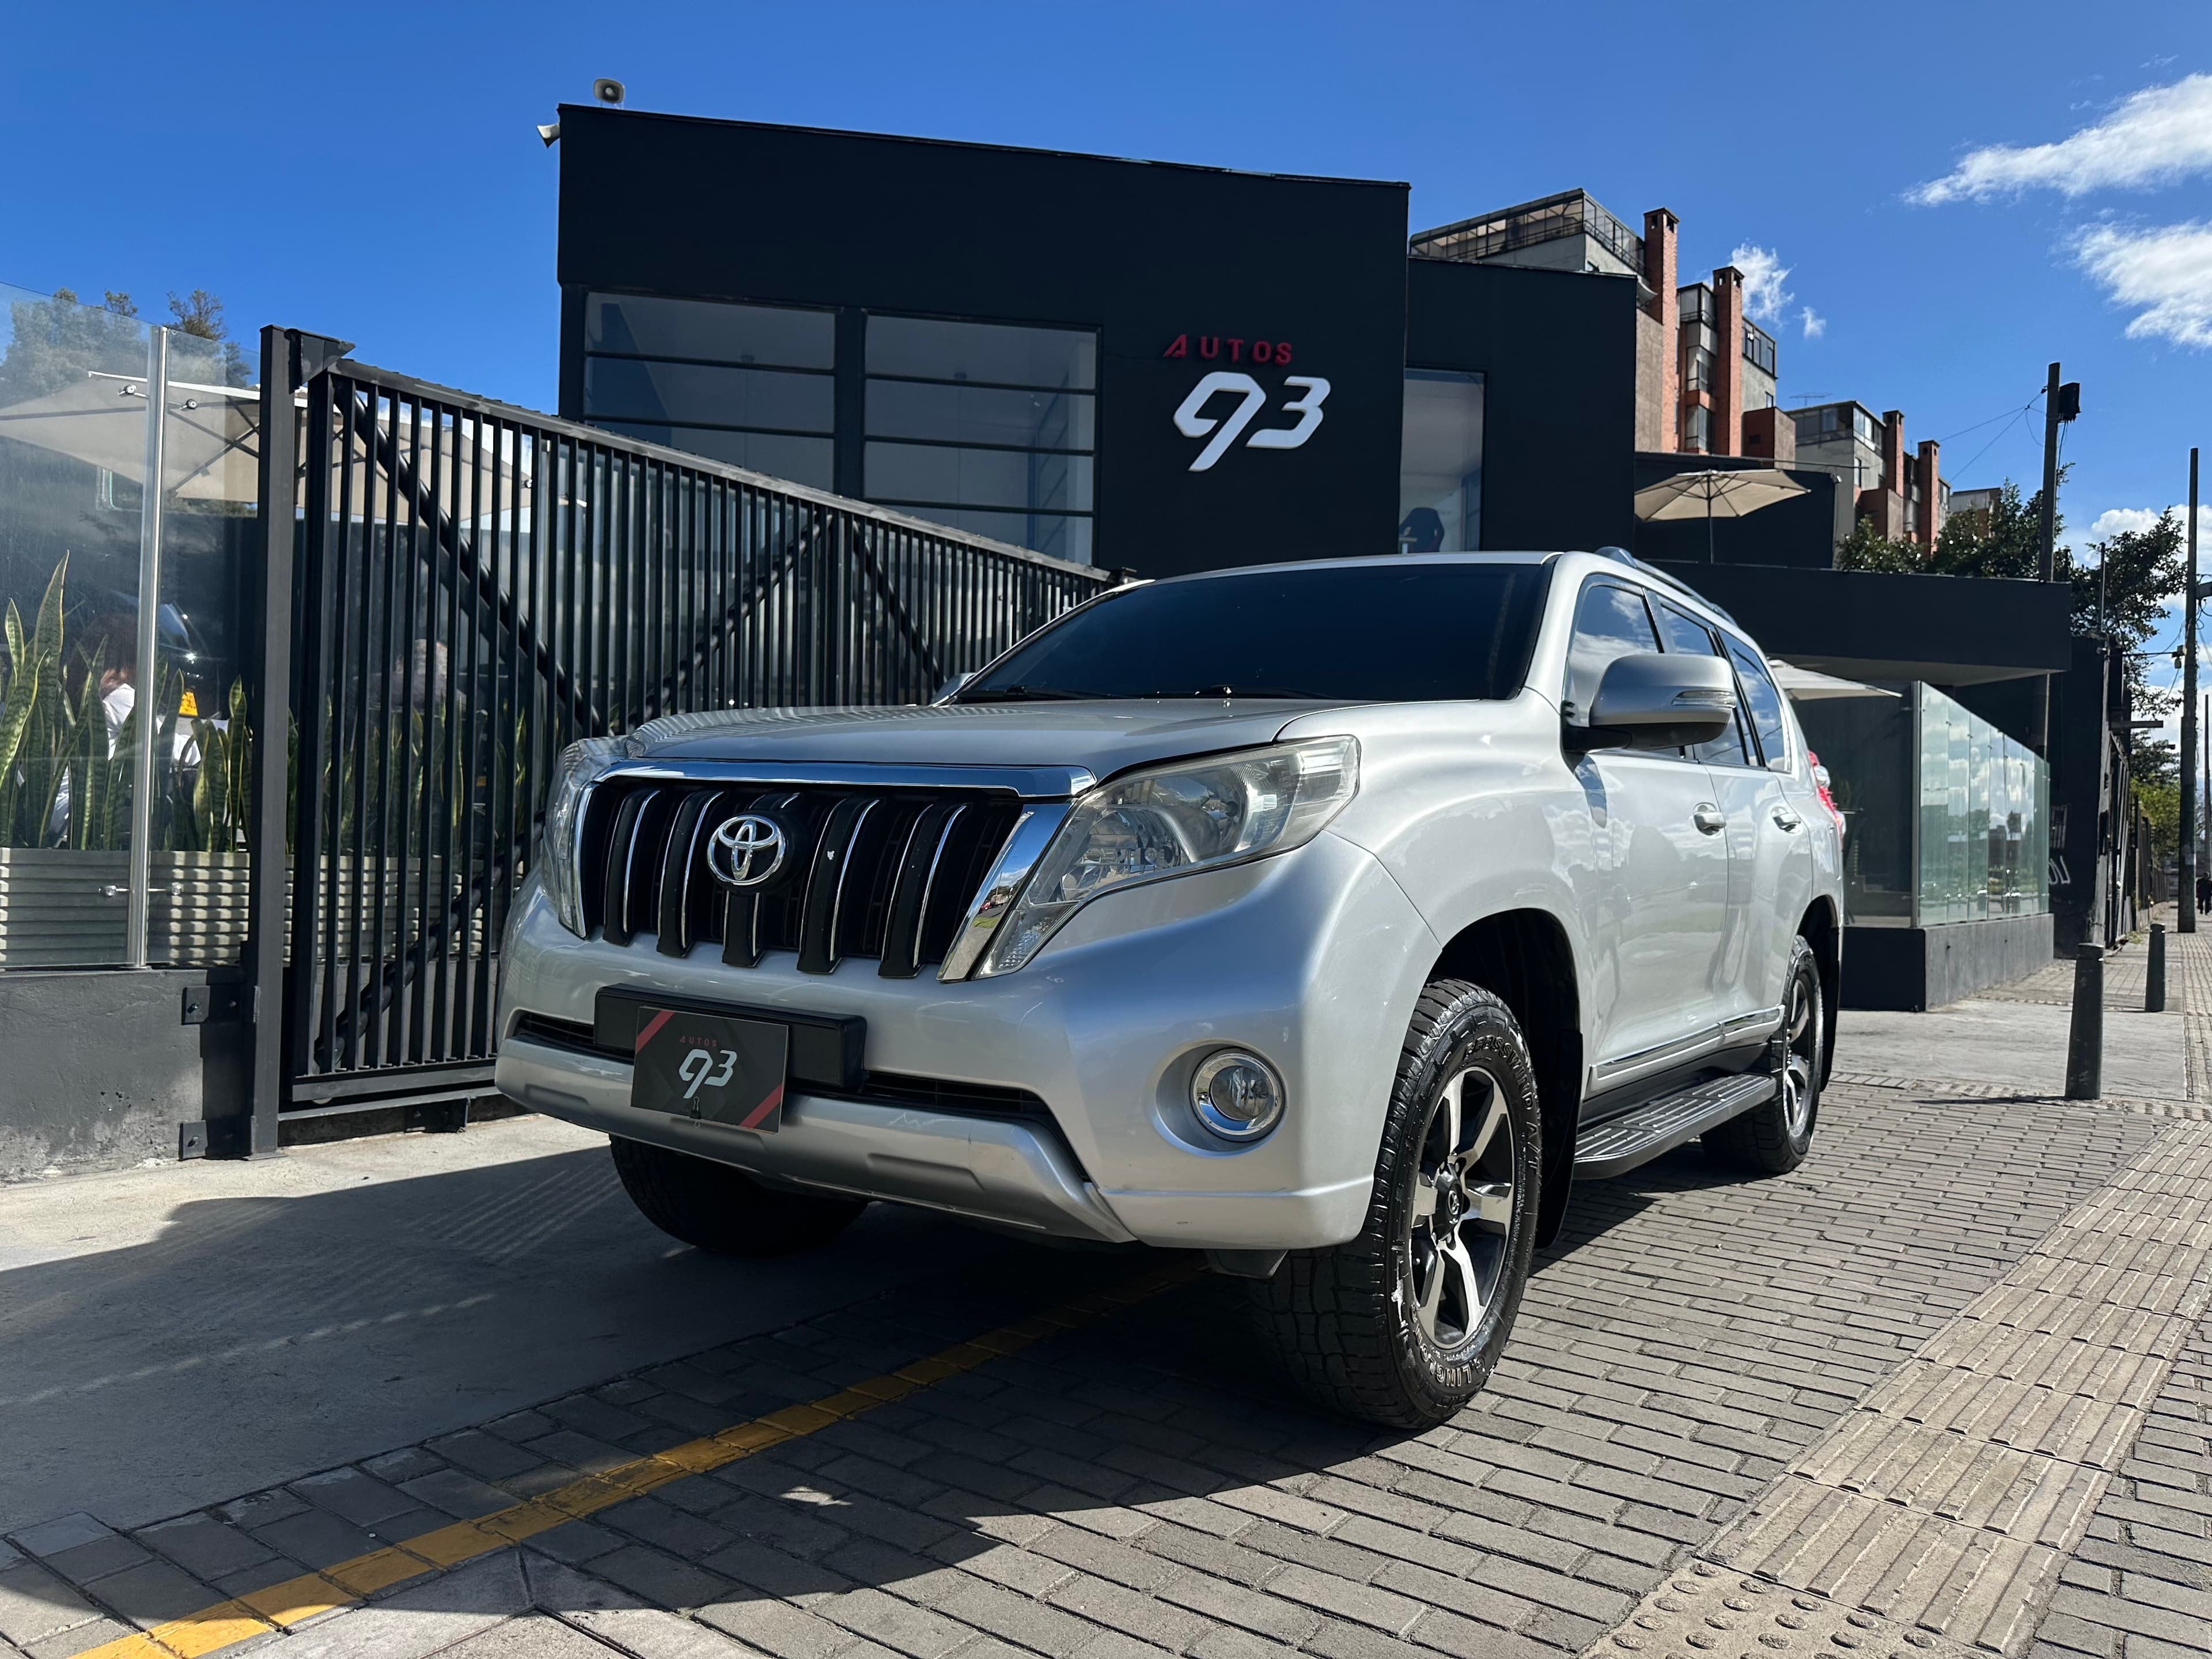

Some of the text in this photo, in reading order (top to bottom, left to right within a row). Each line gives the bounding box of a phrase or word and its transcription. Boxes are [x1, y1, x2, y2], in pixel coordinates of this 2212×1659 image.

[1162, 334, 1293, 366] AUTOS
[1172, 370, 1332, 472] 93
[679, 1035, 718, 1048] AUTOS
[678, 1048, 738, 1100] 93
